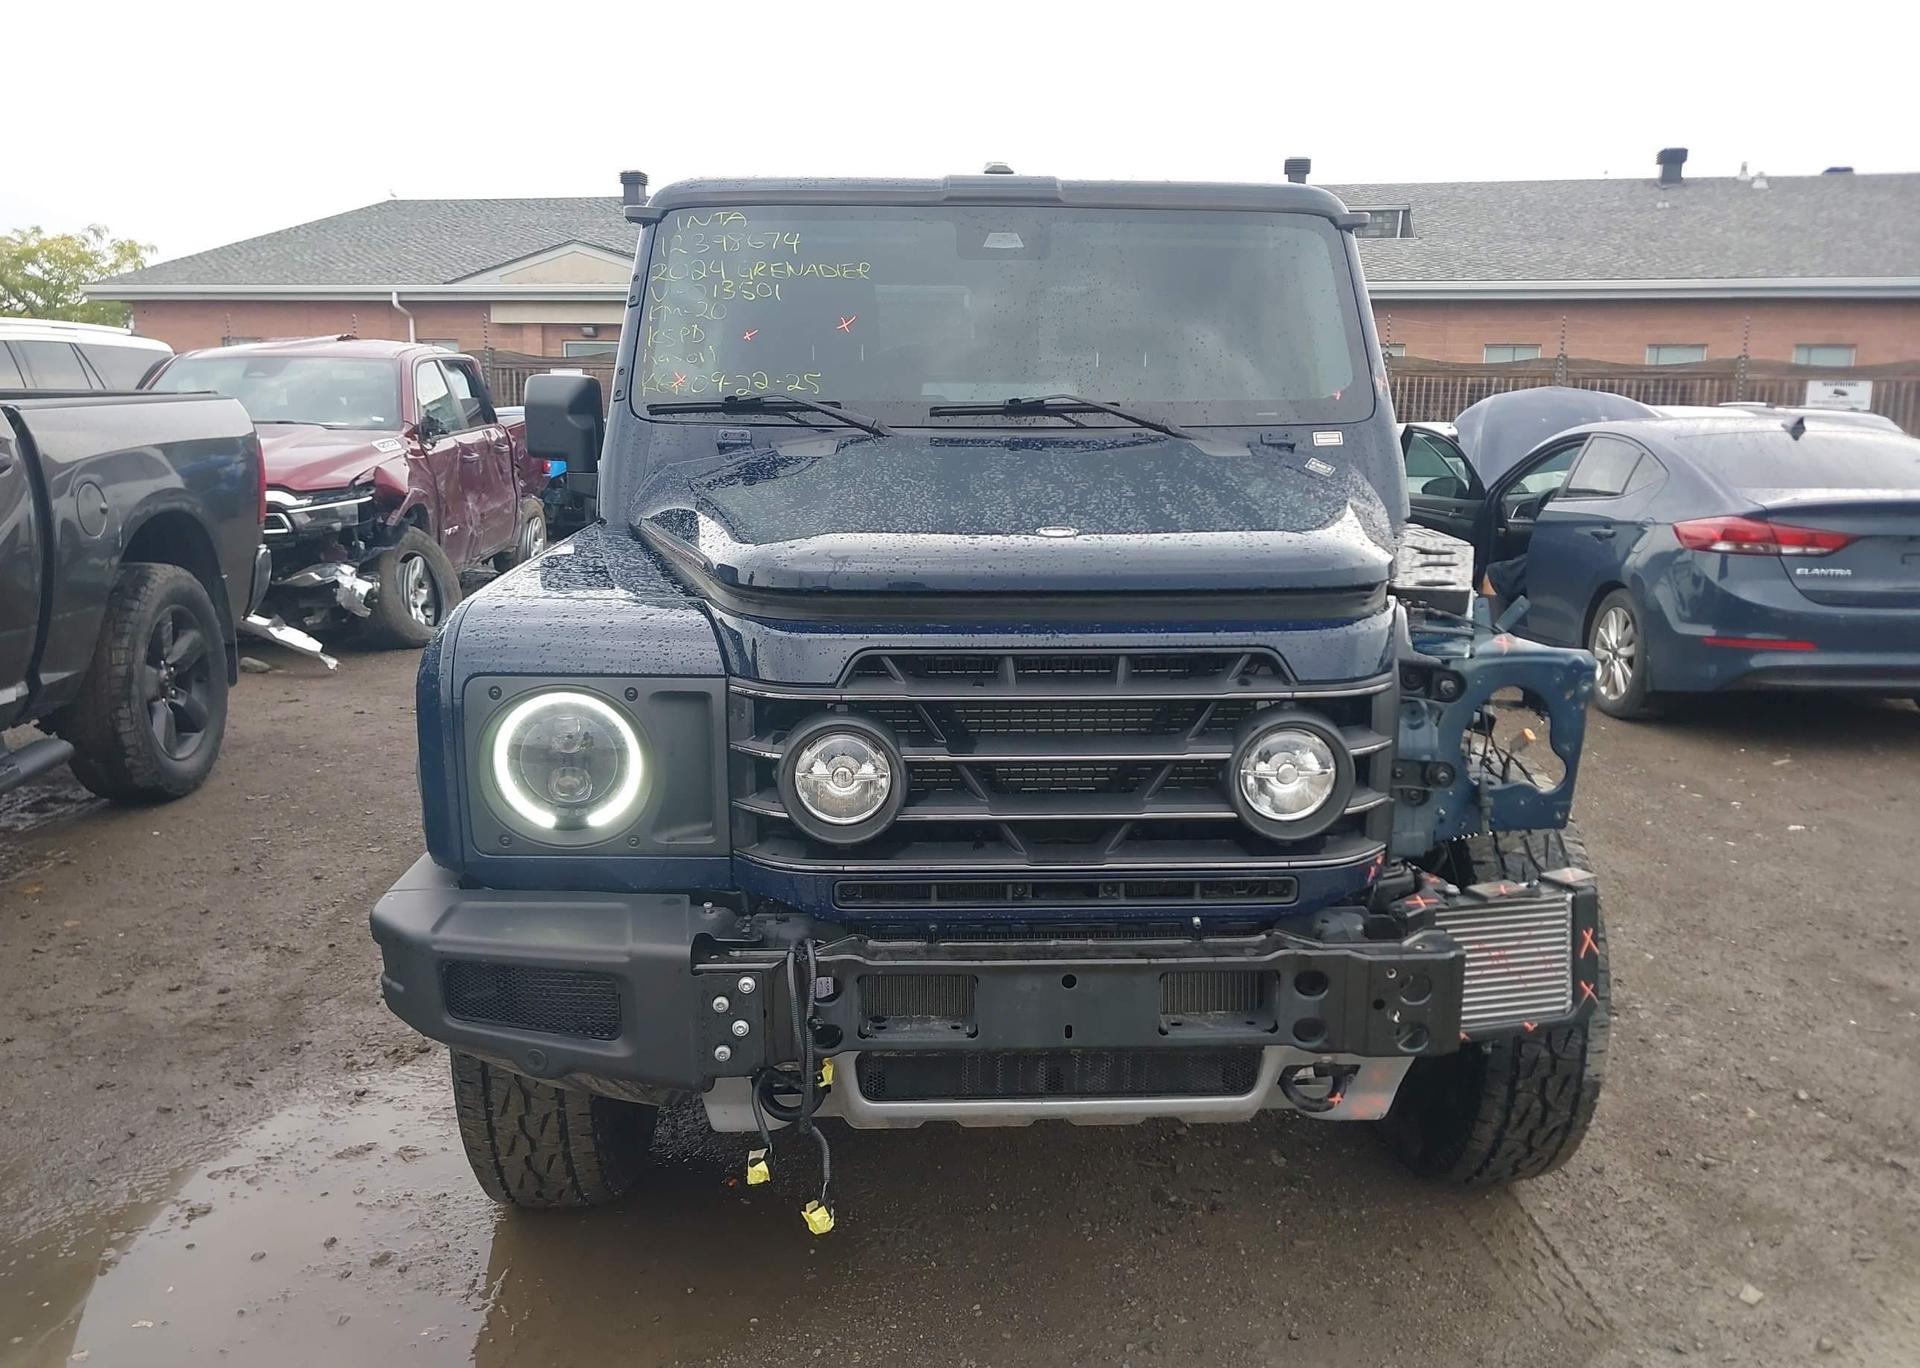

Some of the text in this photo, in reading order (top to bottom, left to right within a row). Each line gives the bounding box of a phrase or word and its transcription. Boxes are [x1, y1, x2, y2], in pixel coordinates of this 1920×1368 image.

[676, 211, 747, 232] INTA
[651, 259, 871, 282] 2024 GRENADIER
[1795, 567, 1852, 577] ELANTRA
